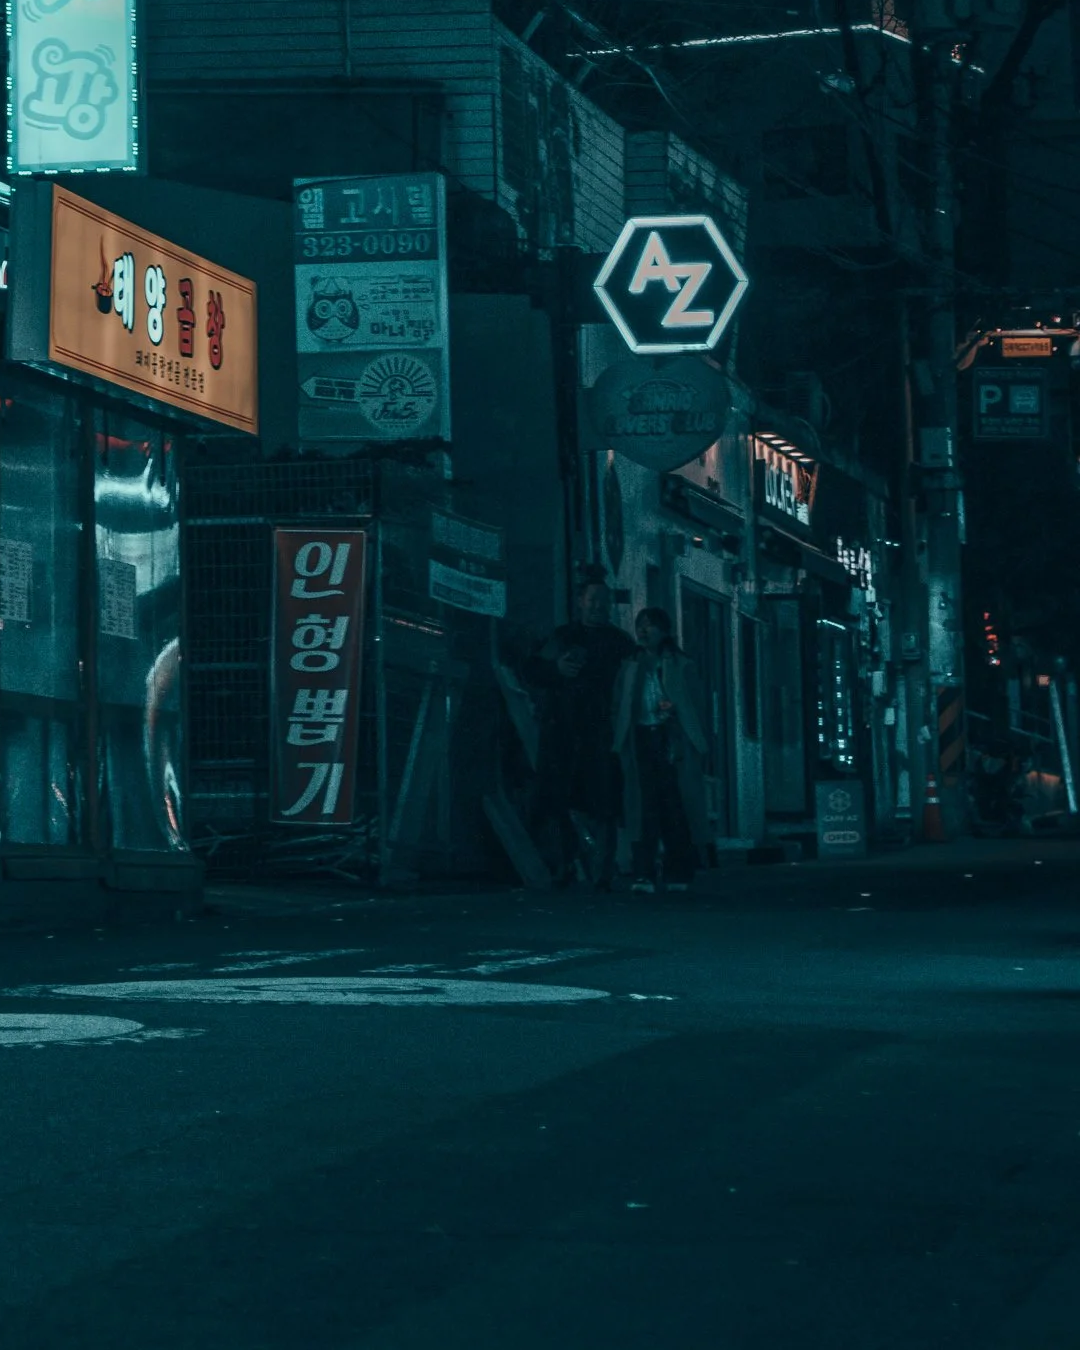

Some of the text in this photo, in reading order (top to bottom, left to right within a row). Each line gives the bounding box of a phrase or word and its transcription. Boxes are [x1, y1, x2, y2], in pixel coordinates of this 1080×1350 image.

[302, 232, 431, 257] 323-0090
[628, 230, 714, 328] AZ
[113, 251, 226, 370] 태양곱창
[280, 540, 352, 817] 인형뽑기
